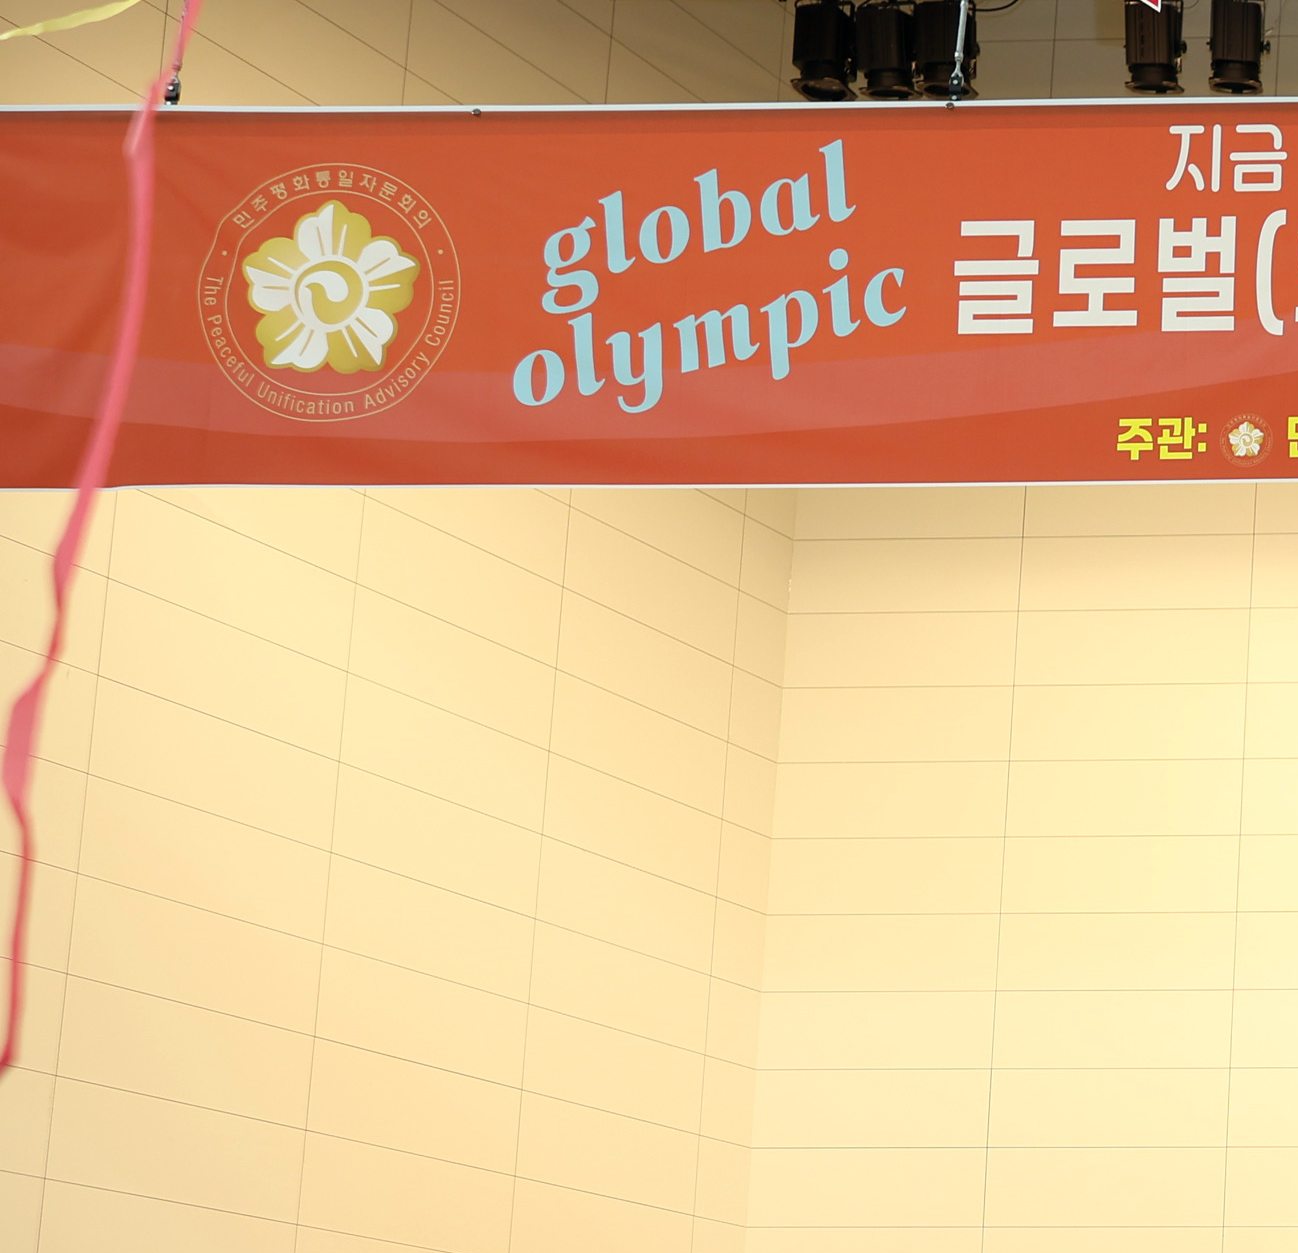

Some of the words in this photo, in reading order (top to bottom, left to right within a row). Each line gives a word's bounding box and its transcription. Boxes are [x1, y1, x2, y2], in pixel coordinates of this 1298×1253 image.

[1165, 122, 1288, 194] 지금
[232, 169, 433, 230] 민주평화통일자문회의
[541, 139, 857, 316] global
[203, 276, 225, 307] The
[425, 279, 455, 348] Council
[206, 313, 256, 388] Peaceful
[512, 247, 908, 414] olympic
[256, 380, 355, 416] Unification
[364, 351, 432, 411] Advisory
[1116, 415, 1207, 462] 주관:
